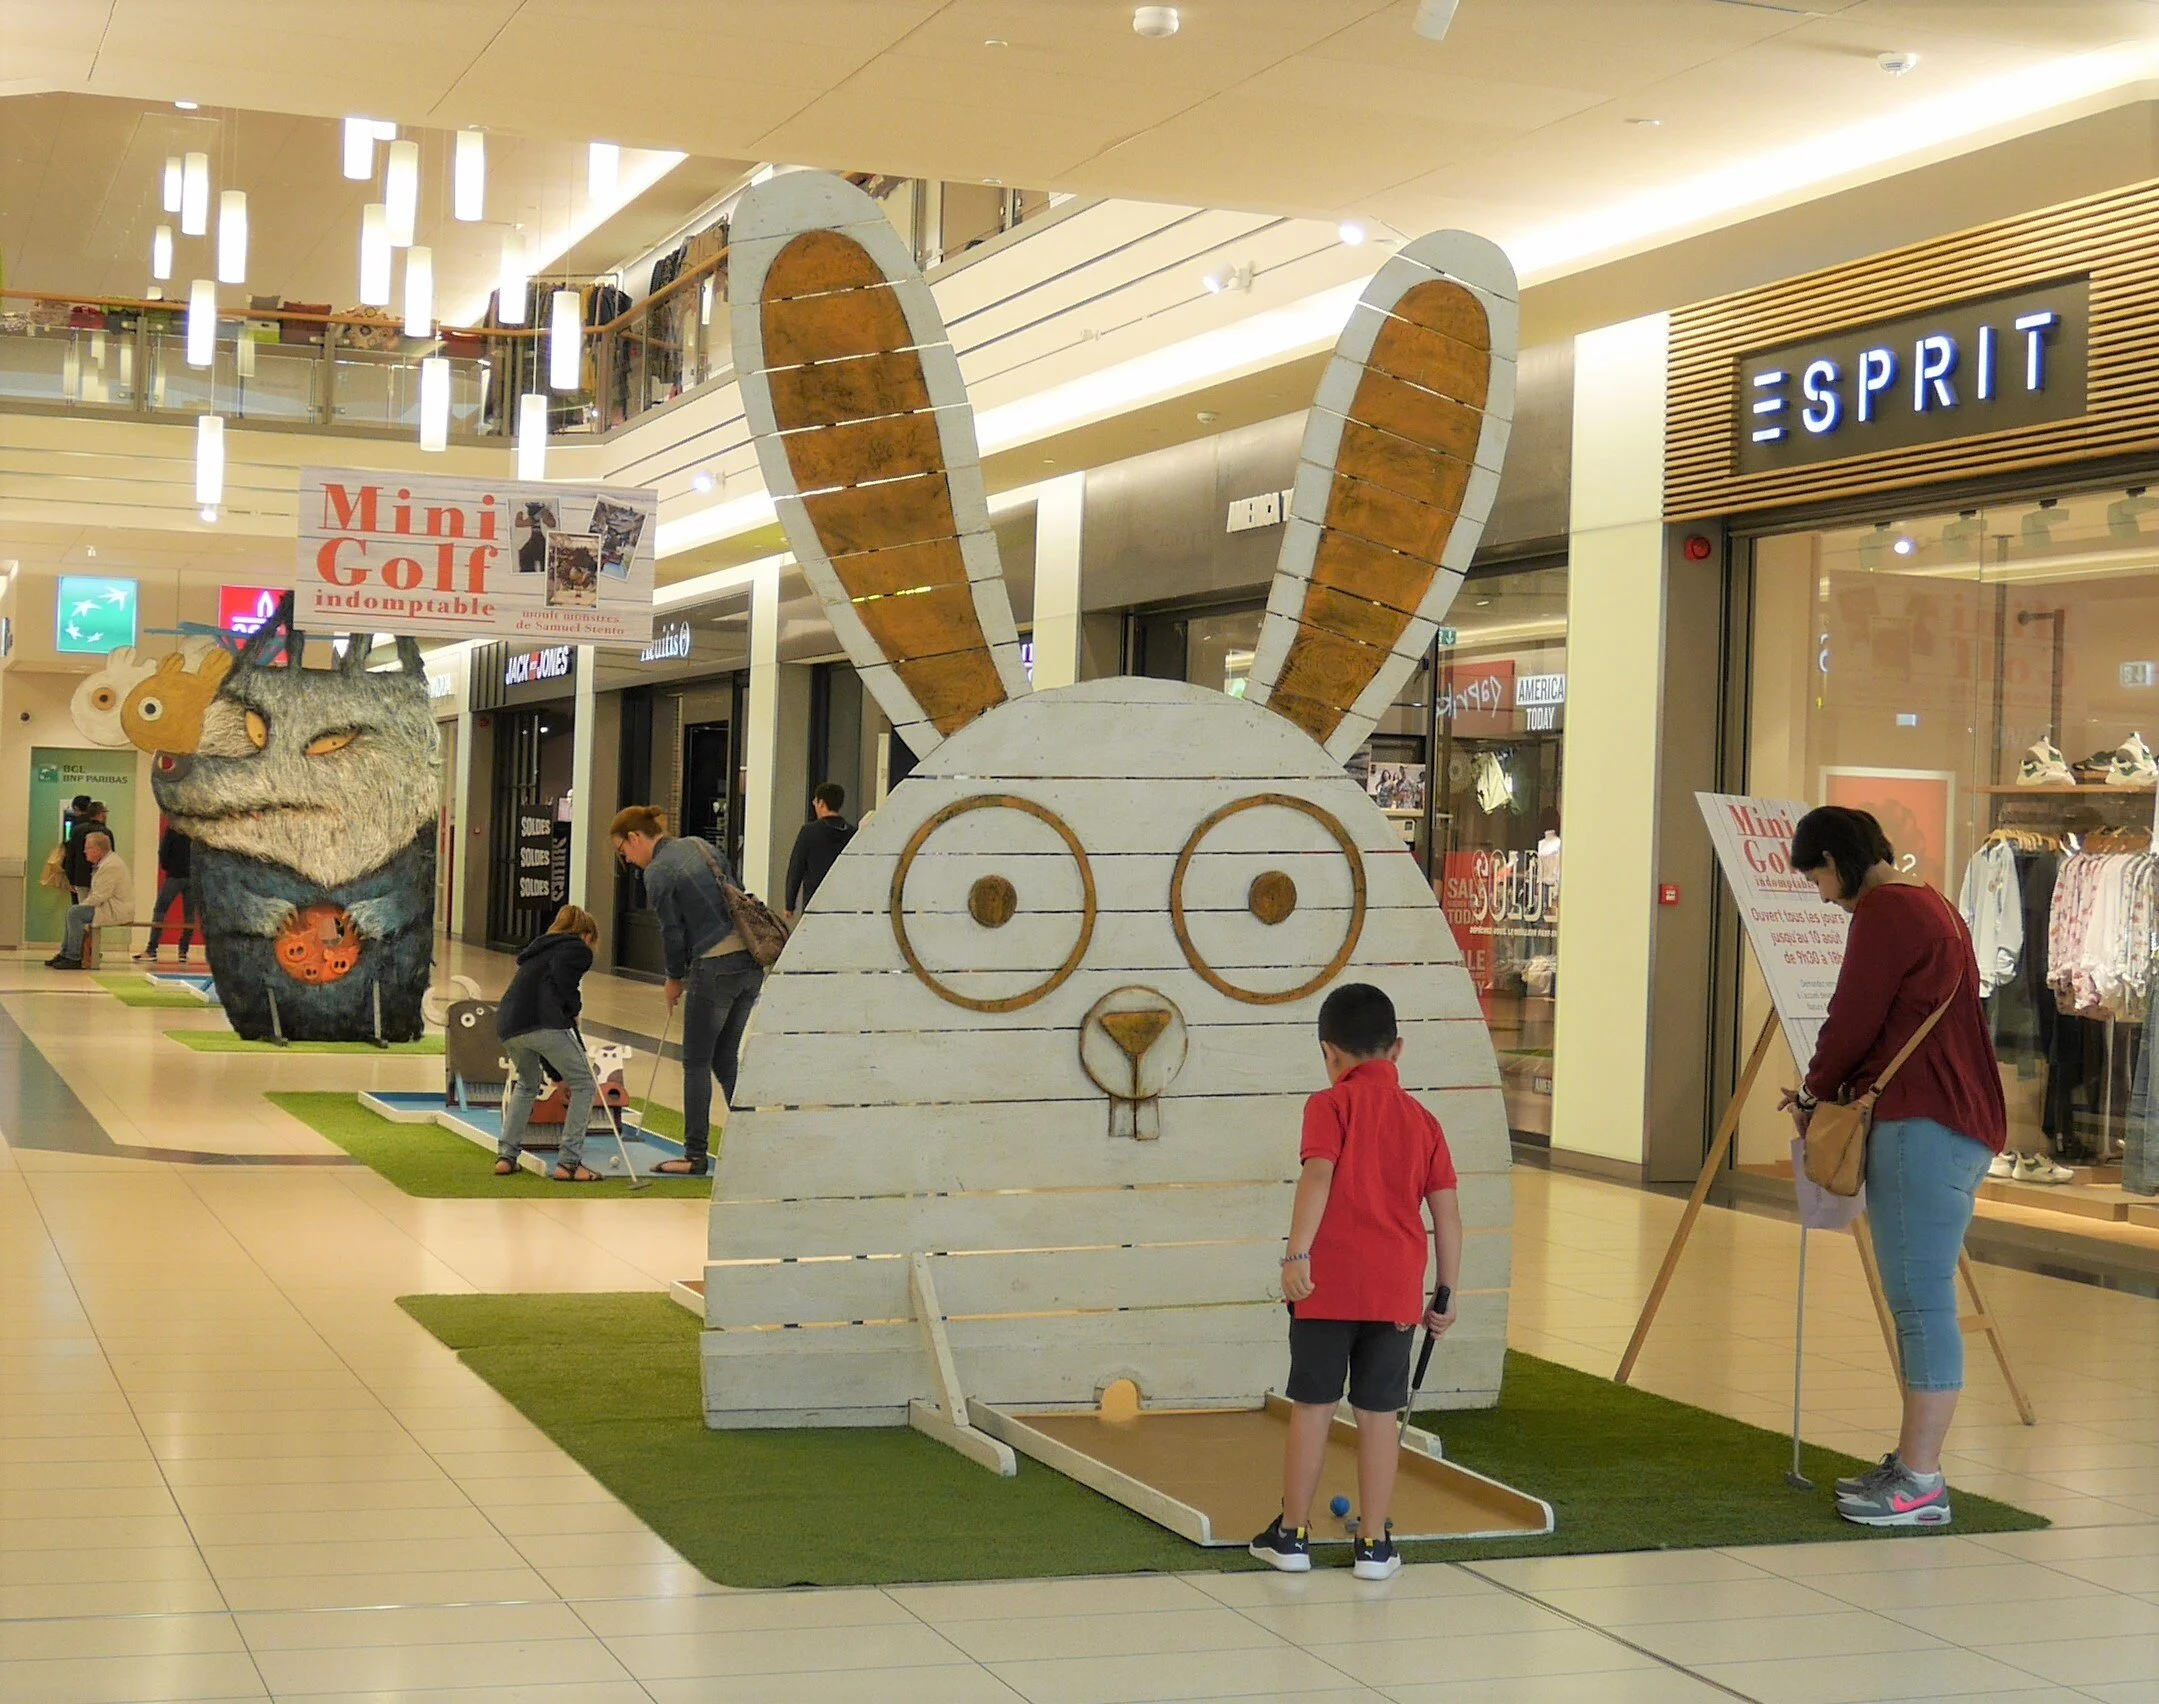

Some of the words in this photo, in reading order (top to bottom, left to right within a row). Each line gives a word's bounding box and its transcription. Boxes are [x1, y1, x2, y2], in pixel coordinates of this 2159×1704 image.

[1752, 311, 2060, 443] ESPRIT
[318, 483, 498, 540] Mini
[316, 537, 499, 594] Golf
[315, 590, 496, 618] indomptable
[516, 620, 531, 630] de
[535, 621, 580, 632] Samuel
[563, 613, 620, 624] monstres
[505, 653, 530, 685] JACK
[536, 645, 569, 679] JONES
[1518, 676, 1565, 702] AMERICA
[1526, 706, 1555, 731] TODAY
[86, 775, 128, 785] PARIBAS
[521, 816, 551, 837] SOLDES
[1727, 804, 1795, 838] Mini
[520, 846, 550, 868] SOLDES
[1743, 840, 1798, 875] Gol
[519, 876, 550, 898] SOLDES
[1471, 849, 1558, 922] SOLDE
[1751, 907, 1782, 922] Ouvert
[1783, 908, 1805, 923] tous
[1804, 909, 1820, 924] les
[1821, 911, 1845, 927] jours
[1808, 930, 1821, 944] 10
[1784, 951, 1797, 965] de
[1796, 950, 1819, 965] 9h30
